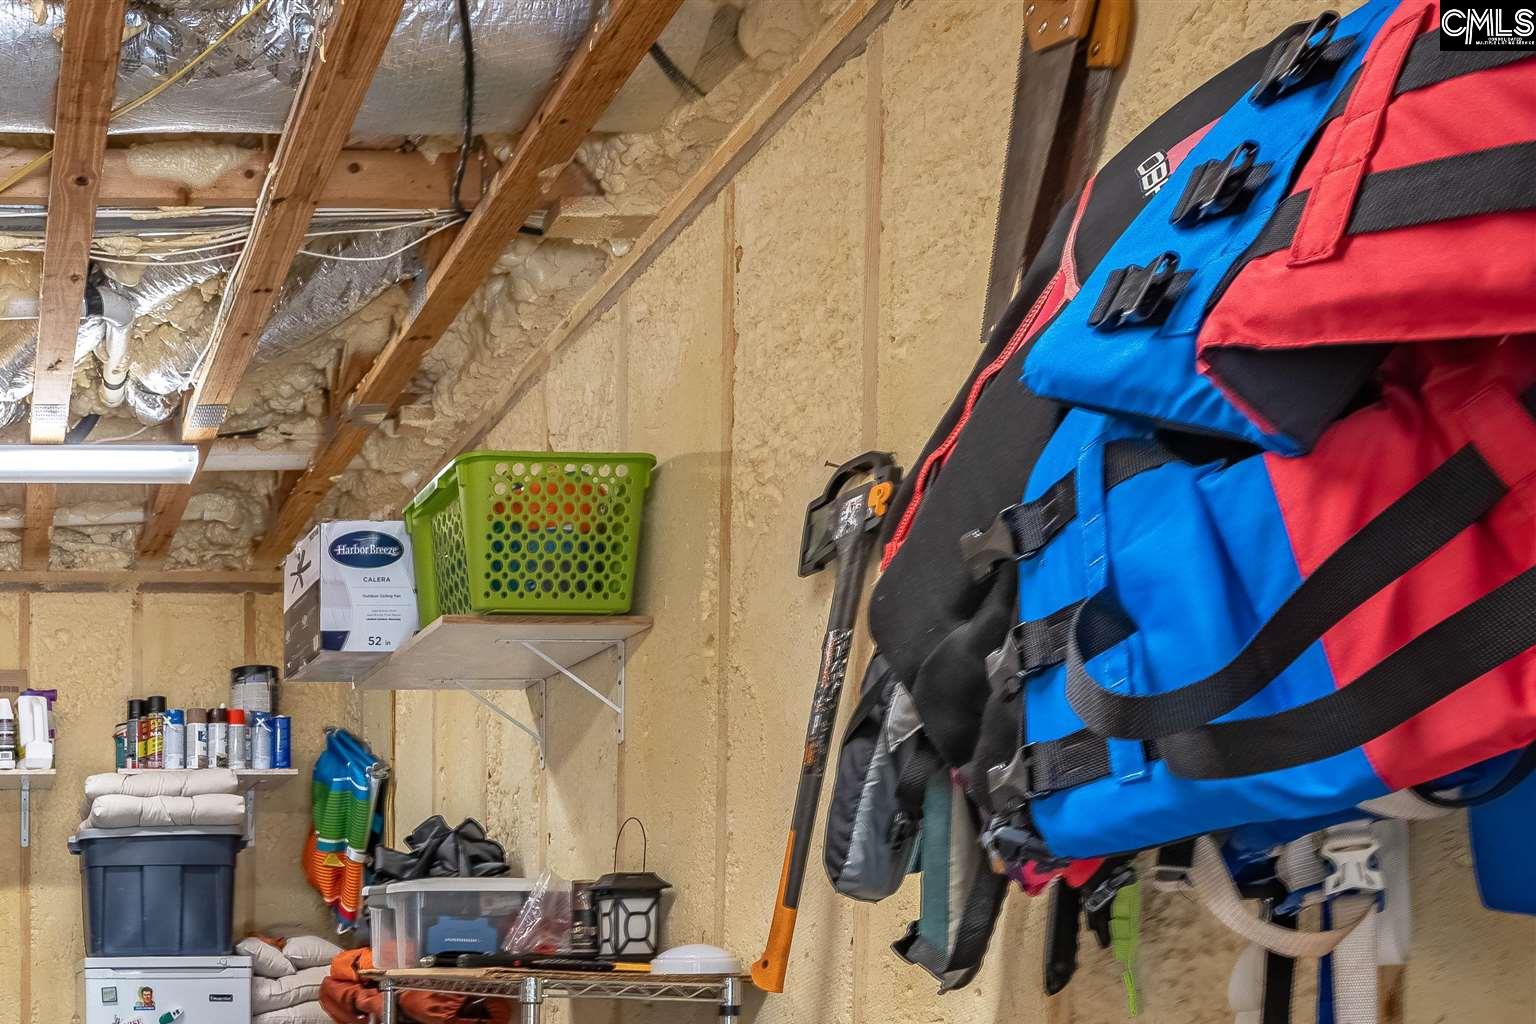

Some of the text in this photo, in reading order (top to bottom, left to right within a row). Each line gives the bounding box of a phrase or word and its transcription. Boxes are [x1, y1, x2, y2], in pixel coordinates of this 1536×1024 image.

[335, 544, 398, 556] Harbor Breeze
[368, 636, 382, 646] 52
